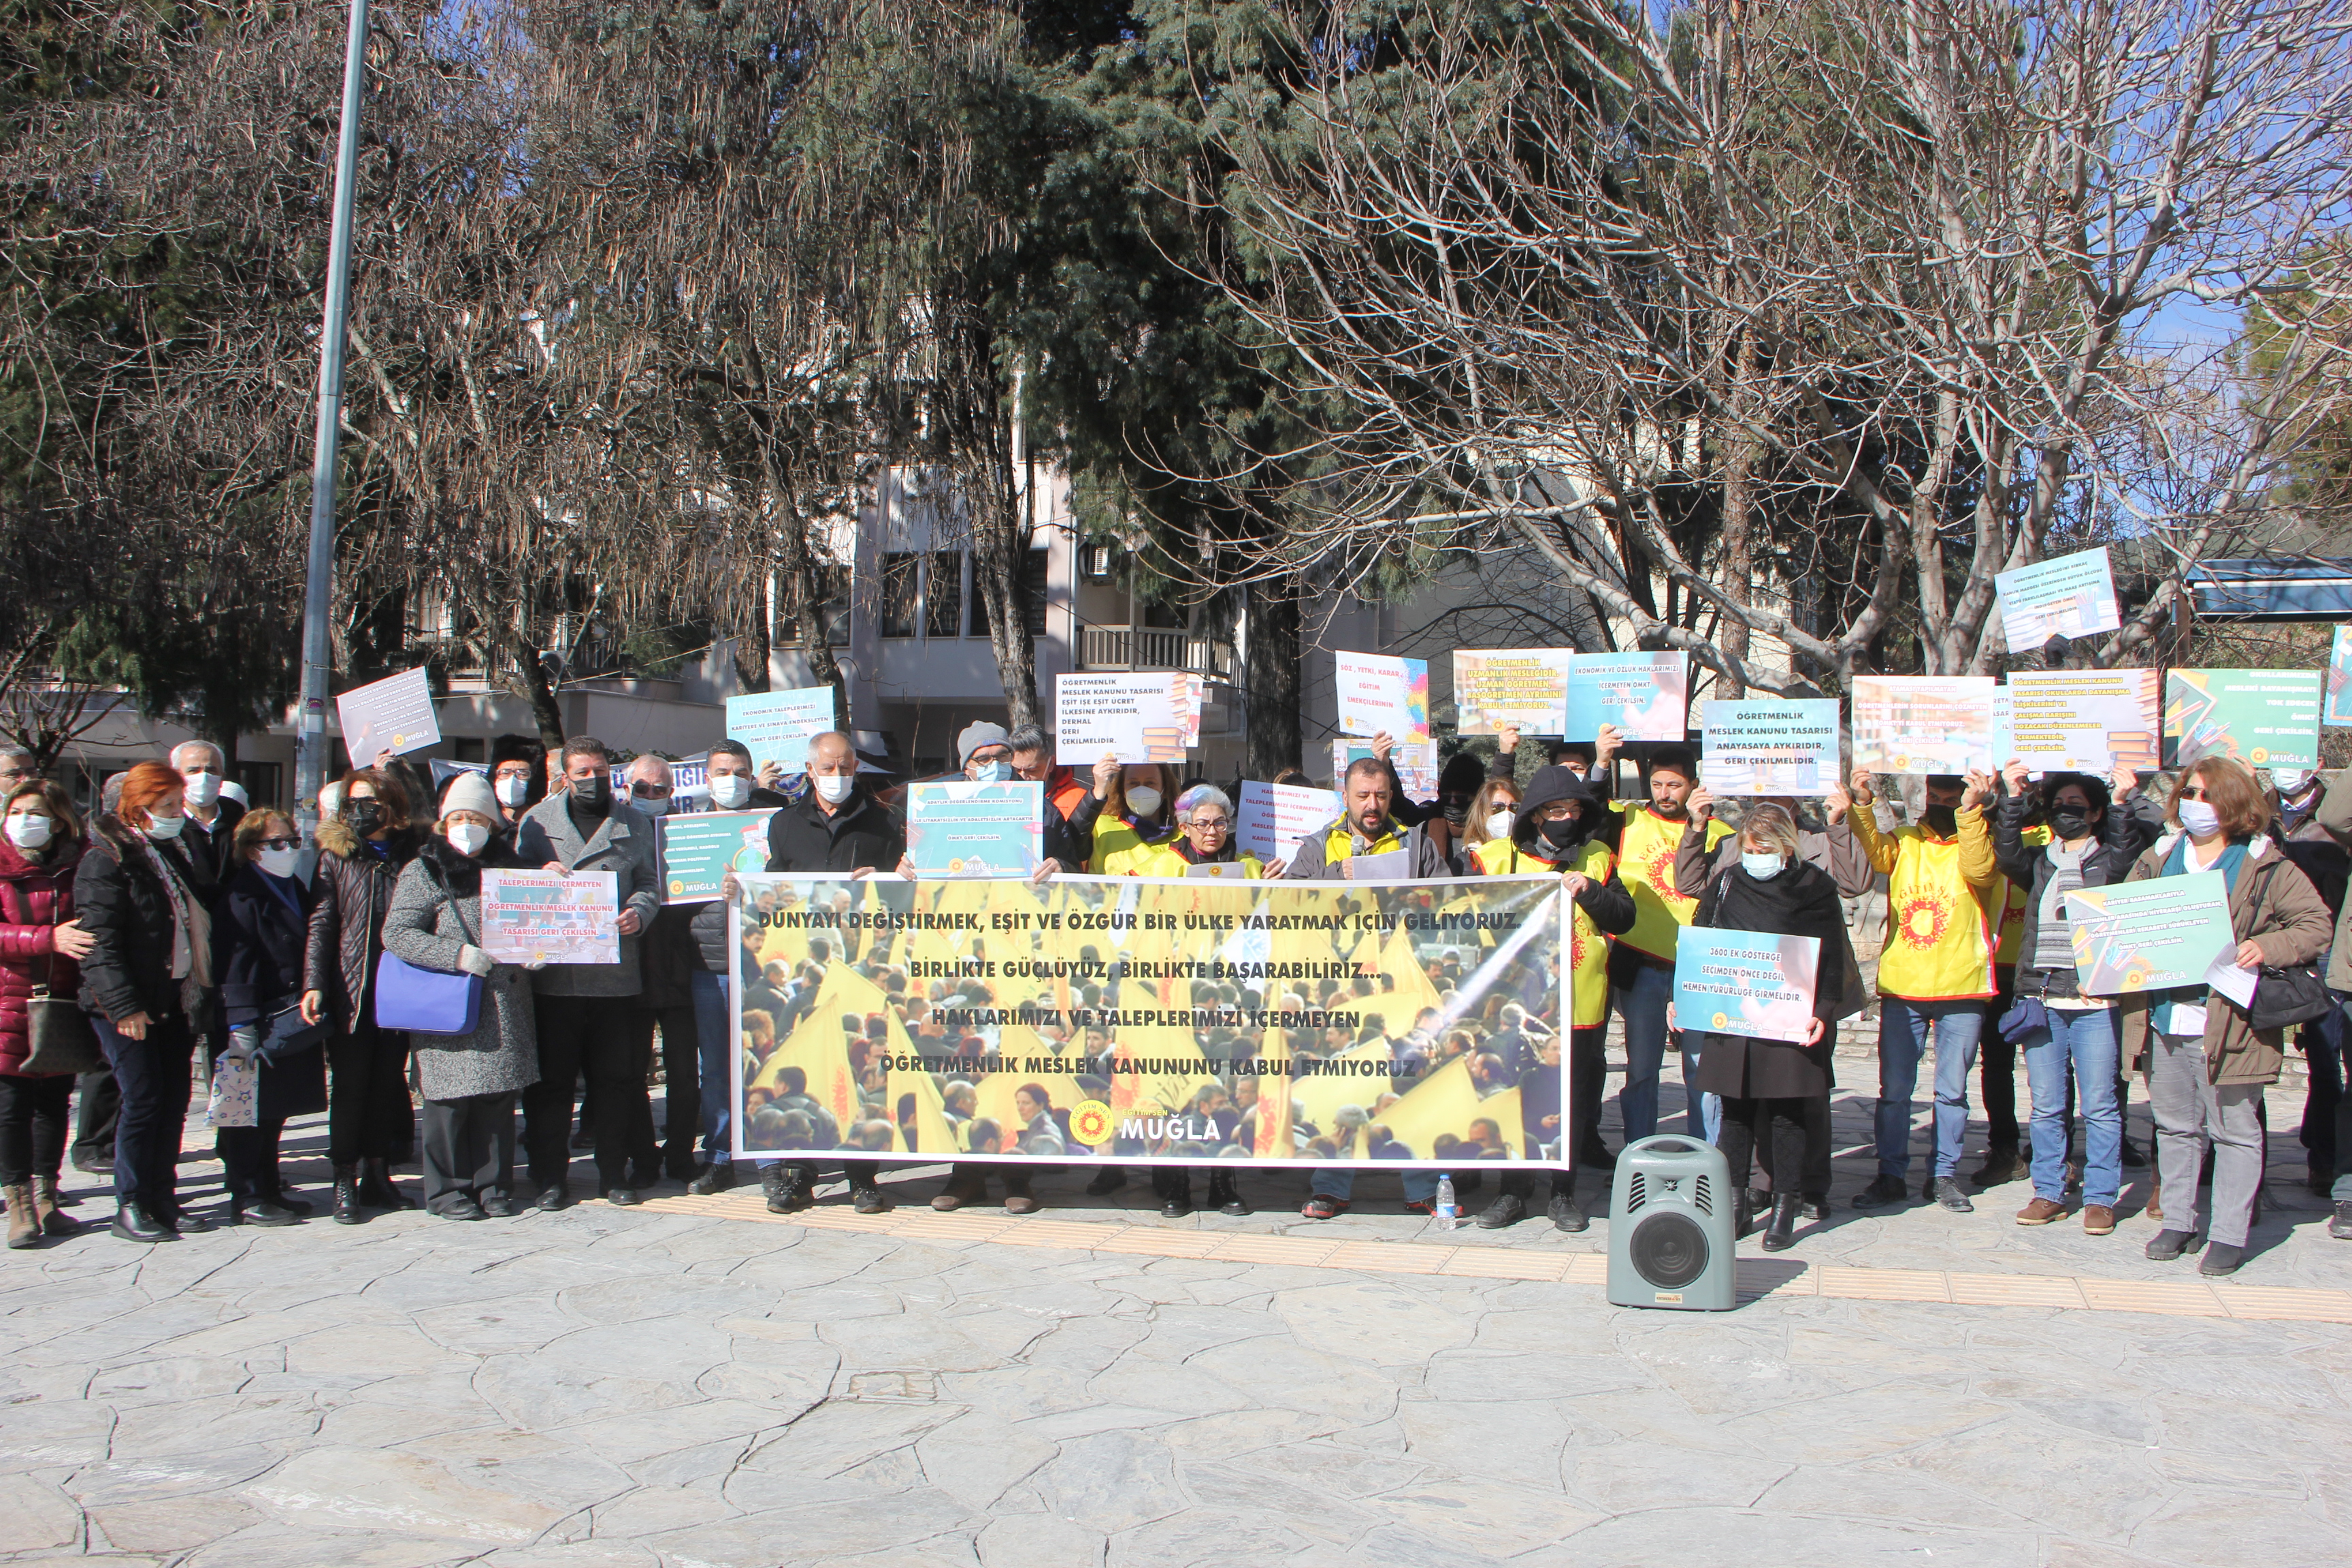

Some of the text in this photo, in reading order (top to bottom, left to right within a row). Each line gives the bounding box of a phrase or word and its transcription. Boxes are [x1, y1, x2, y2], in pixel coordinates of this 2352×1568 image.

[1486, 657, 1541, 666] ÖĞRETMENLİK
[1358, 666, 1376, 676] YETKİ,
[1511, 668, 1559, 677] MESLEĞİDİR.
[1575, 665, 1606, 674] EKONOMİK
[1617, 664, 1636, 672] ÖZLÜK
[1507, 679, 1551, 688] ÖĞRETMEN,
[1599, 680, 1650, 690] İÇERMEYEN ÖMKT
[1467, 689, 1522, 700] BAŞÖĞRETMEN
[1348, 697, 1394, 708] EMEKÇİLERİNİN
[1505, 700, 1551, 709] ETMİYORUZ.
[1602, 696, 1645, 706] GERİ ÇEKİLSİN.
[2014, 700, 2056, 708] İLİŞKİLERİNİ
[1737, 710, 1803, 719] ÖĞRETMENLİK
[2015, 733, 2065, 742] İÇERMEKTEDİR,
[2033, 744, 2065, 752] ÇEKİLSİN.
[1750, 755, 1817, 766] ÇEKİLMELİDİR.
[2270, 752, 2308, 762] MUĞLA
[1911, 758, 1946, 768] MUĞLA
[1262, 789, 1300, 798] HAKLARIMIZI
[1245, 799, 1322, 812] TALEPLERİMİZİ İÇERMEYEN
[1262, 811, 1303, 821] ÖĞRETMENLİK
[1639, 838, 1676, 861] EĞİTİ
[966, 862, 1000, 871] MUĞLA
[499, 879, 602, 889] TALEPLERİMİZİ İÇERMEYEN
[686, 882, 717, 892] MUĞLA
[2103, 891, 2185, 906] KARİYER BASAMAKLARIYLA
[488, 902, 544, 911] ÖĞRETMENLİK
[2072, 915, 2115, 925] ÖĞRETMENLER
[2117, 911, 2148, 920] ARASINDA
[2183, 901, 2223, 911] OLUŞTURAN,
[759, 906, 1521, 935] DÜNYAYI DEĞİŞTİRMEK, EŞİT VE ÖZGÜR BİR ÜLKE YARATMAK İÇİN GELİYORUZ.
[561, 928, 599, 938] ÇEKİLSİN.
[2090, 918, 2208, 938] ÖĞRETMENLERİ REKABETE SÜRÜKLEYEN
[2138, 936, 2184, 948] GERİ ÇEKİLSİN.
[1710, 948, 1727, 957] 3600
[1742, 949, 1781, 961] GÖSTERGE
[911, 956, 1382, 983] BİRLİKTE GÜÇLÜYÜZ, BİRLİKTE BAŞARABİLİRİZ...
[1702, 964, 1784, 981] SEÇİMDEN ÖNCE DEĞİL
[2146, 970, 2187, 983] MUĞLA
[1683, 983, 1801, 1002] HEMEN YÜRÜRLÜĞE GİRMELİDİR.
[932, 1005, 1360, 1032] HAKLARIMIZI VE TALEPLERİMİZİ İÇERMEYEN
[1729, 1019, 1763, 1031] MUĞLA
[881, 1051, 1416, 1077] ÖĞRETMENLİK MESLEK KANUNUNU KABUL ETMİYORUZ
[1121, 1113, 1220, 1140] MUĞLA
